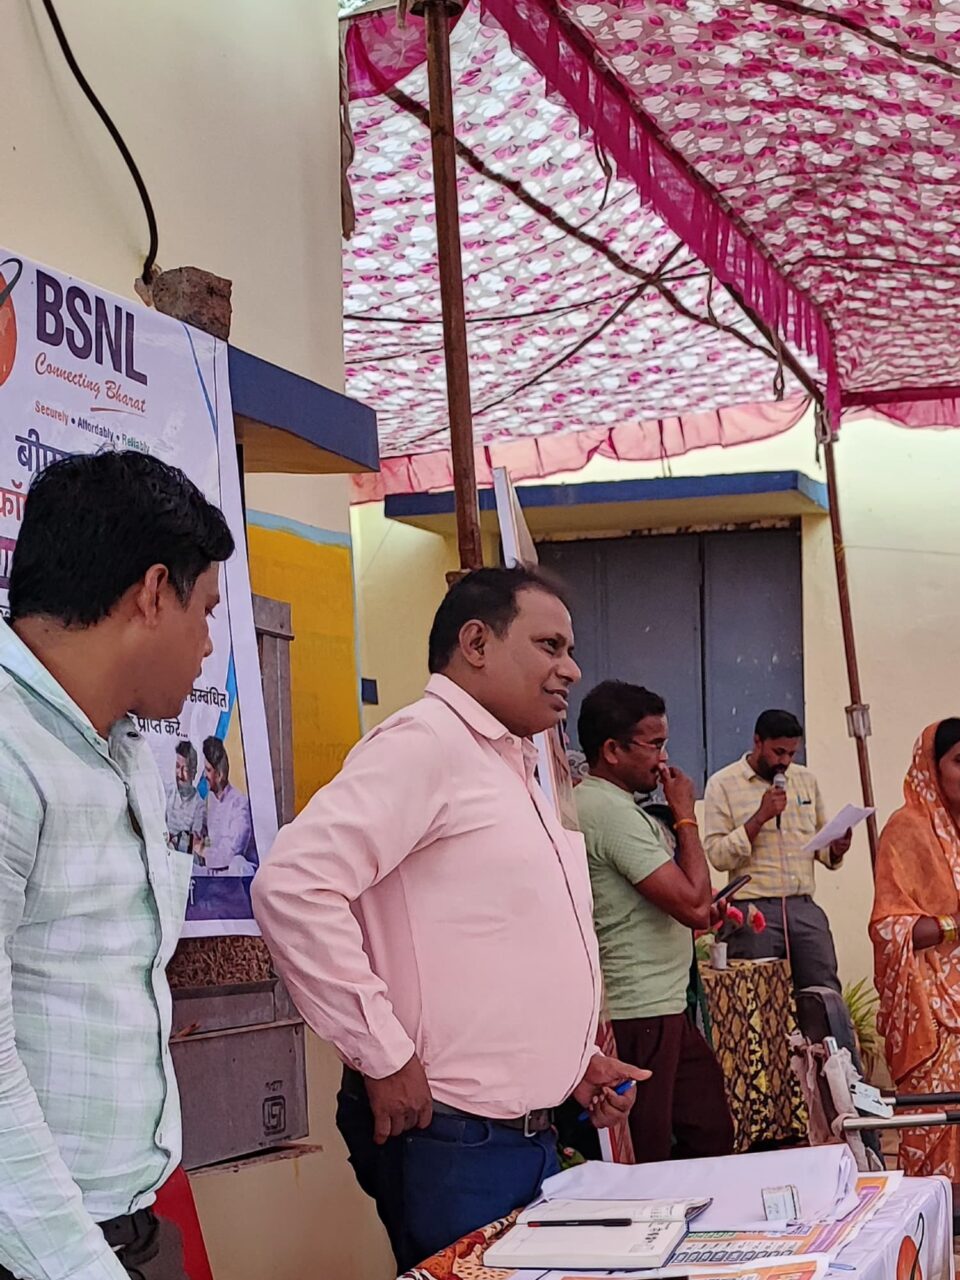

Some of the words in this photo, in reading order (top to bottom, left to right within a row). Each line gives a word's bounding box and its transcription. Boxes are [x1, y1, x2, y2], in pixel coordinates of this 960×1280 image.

[36, 269, 148, 386] BSNL
[35, 352, 101, 400] Connecting
[105, 380, 146, 413] Bharat
[34, 400, 70, 426] Securely
[77, 417, 114, 443] Affordably
